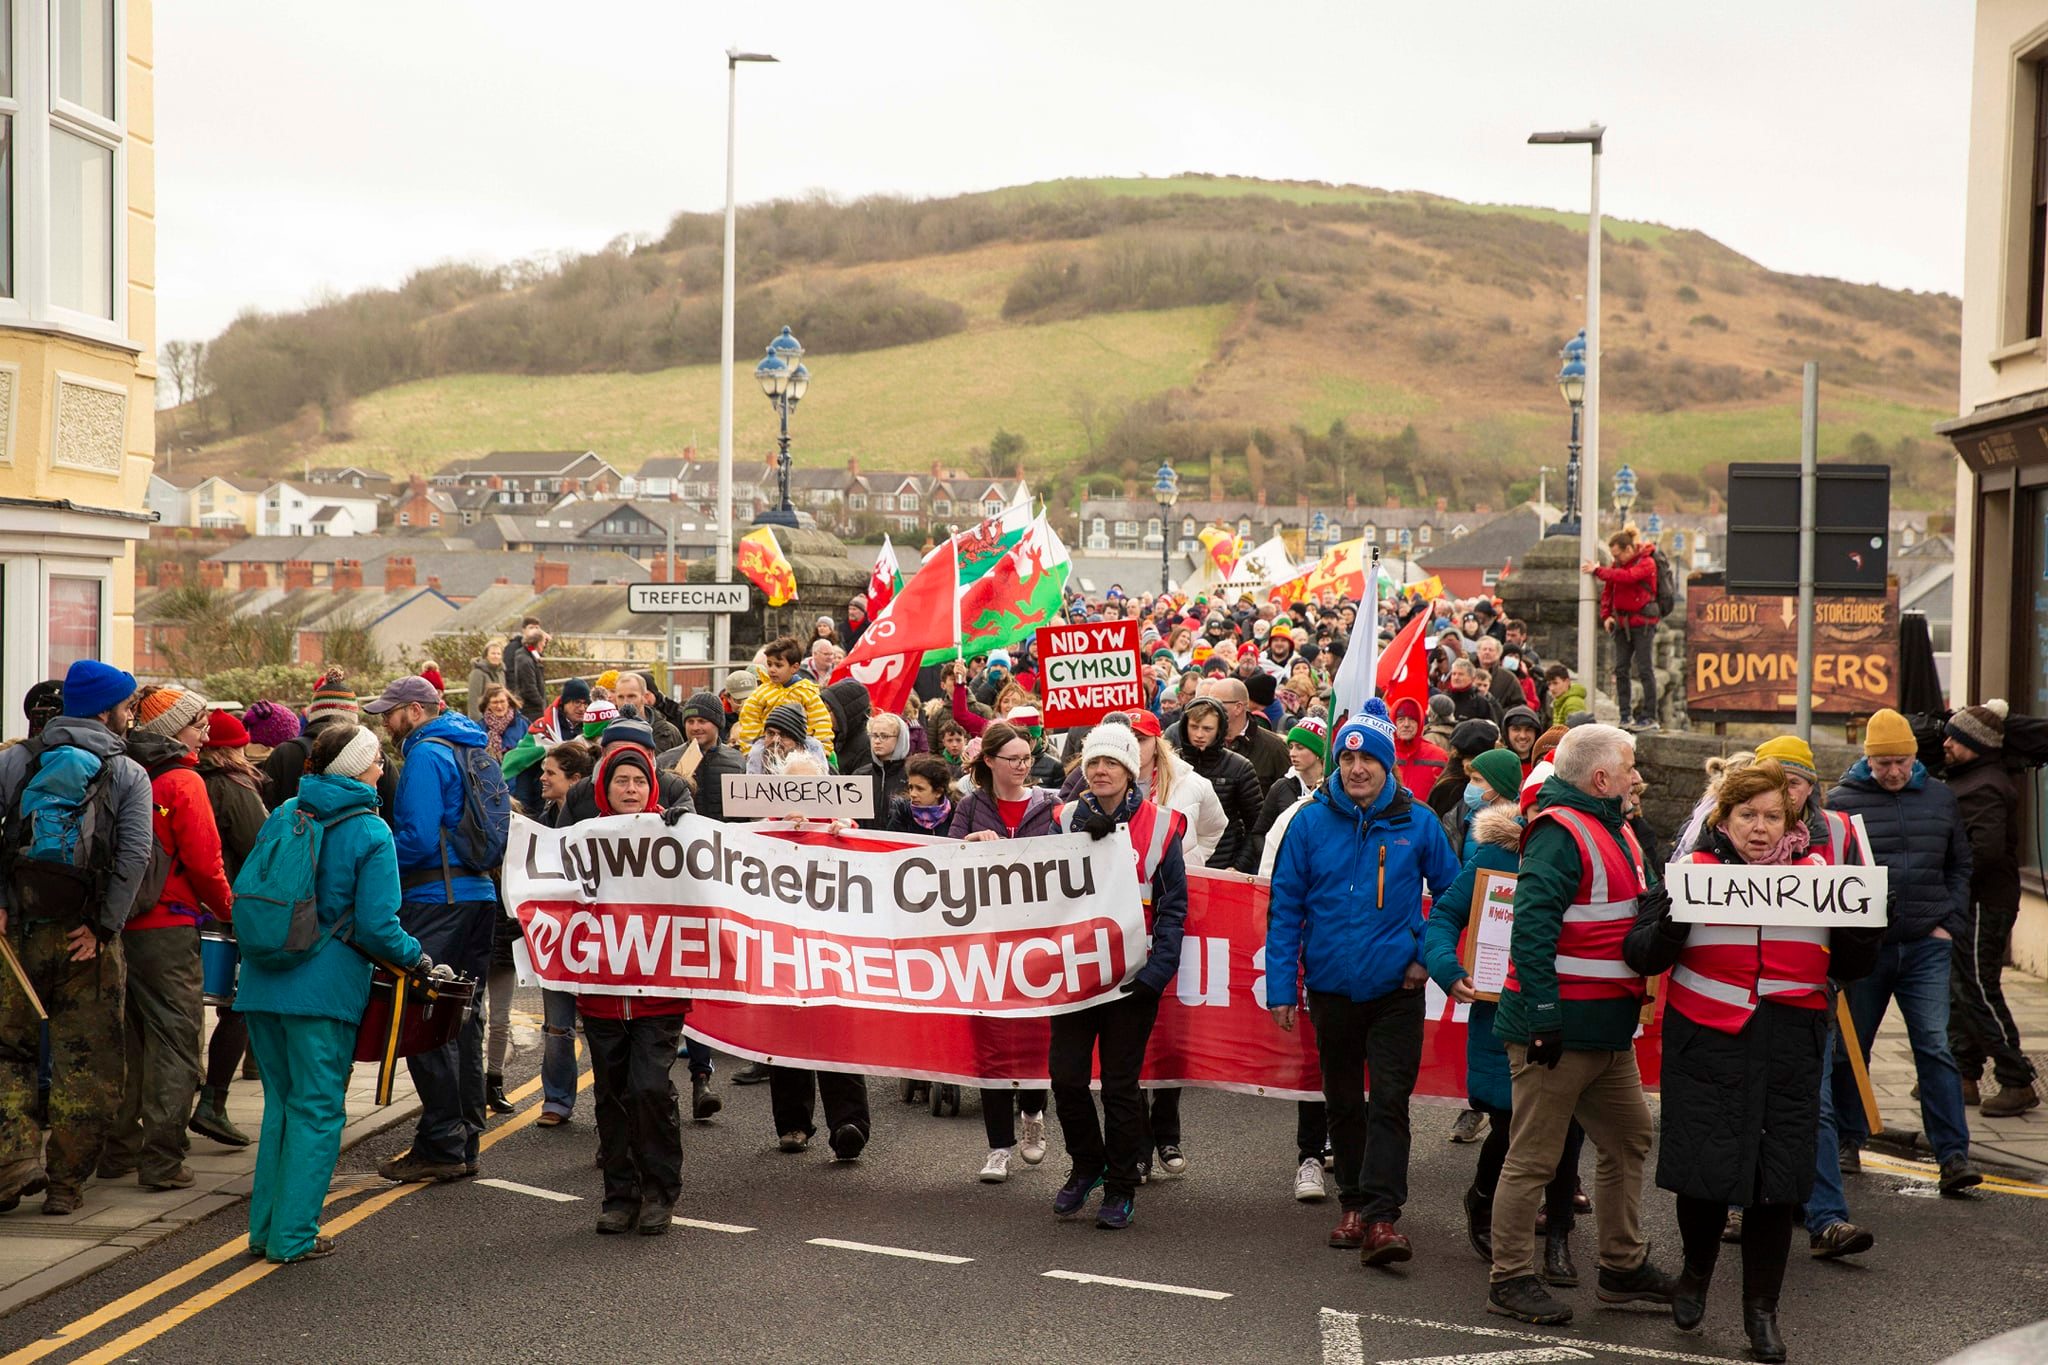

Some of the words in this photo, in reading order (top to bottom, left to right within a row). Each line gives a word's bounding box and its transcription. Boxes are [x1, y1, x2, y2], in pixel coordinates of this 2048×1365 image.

[639, 591, 741, 604] TREFECHAN
[1706, 603, 1758, 623] STORDY
[1815, 603, 1886, 624] STOREHOUSE
[1050, 631, 1089, 654] NID
[1090, 626, 1126, 651] YW
[1049, 656, 1131, 682] CYMRU
[1045, 689, 1075, 711] AR
[1073, 683, 1138, 709] WERTH
[730, 781, 863, 804] LLANBERIS
[525, 830, 874, 914] Llywodraeth
[893, 855, 1096, 927] Cymru
[1684, 873, 1872, 914] LLANRUG
[560, 911, 1113, 1002] GWEITHREDWCH
